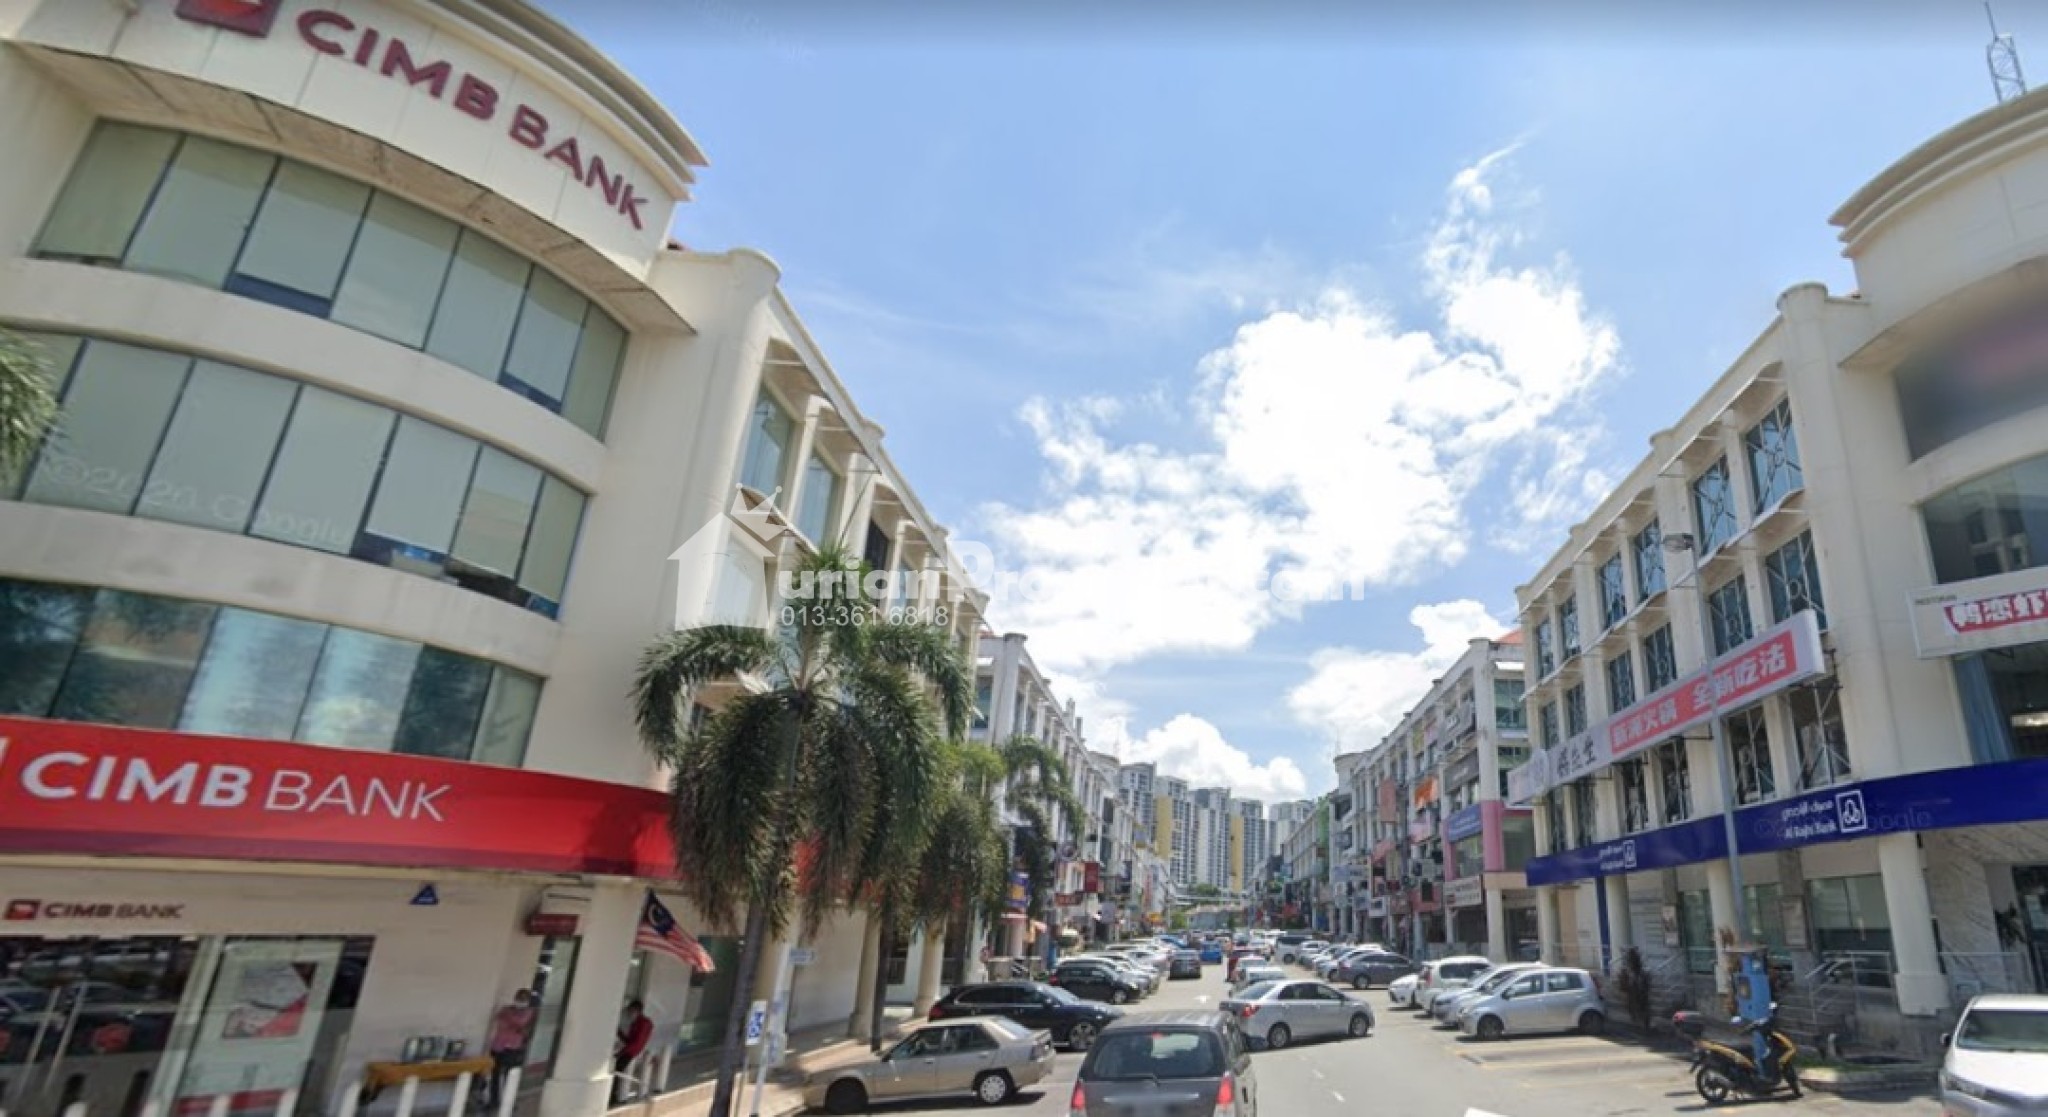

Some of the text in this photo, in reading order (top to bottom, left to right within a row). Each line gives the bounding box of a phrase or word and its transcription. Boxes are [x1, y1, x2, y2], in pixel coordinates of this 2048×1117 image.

[297, 9, 648, 230] CIMB BANK
[19, 752, 451, 822] CIMB BANK
[44, 903, 185, 919] CIMB BANK
